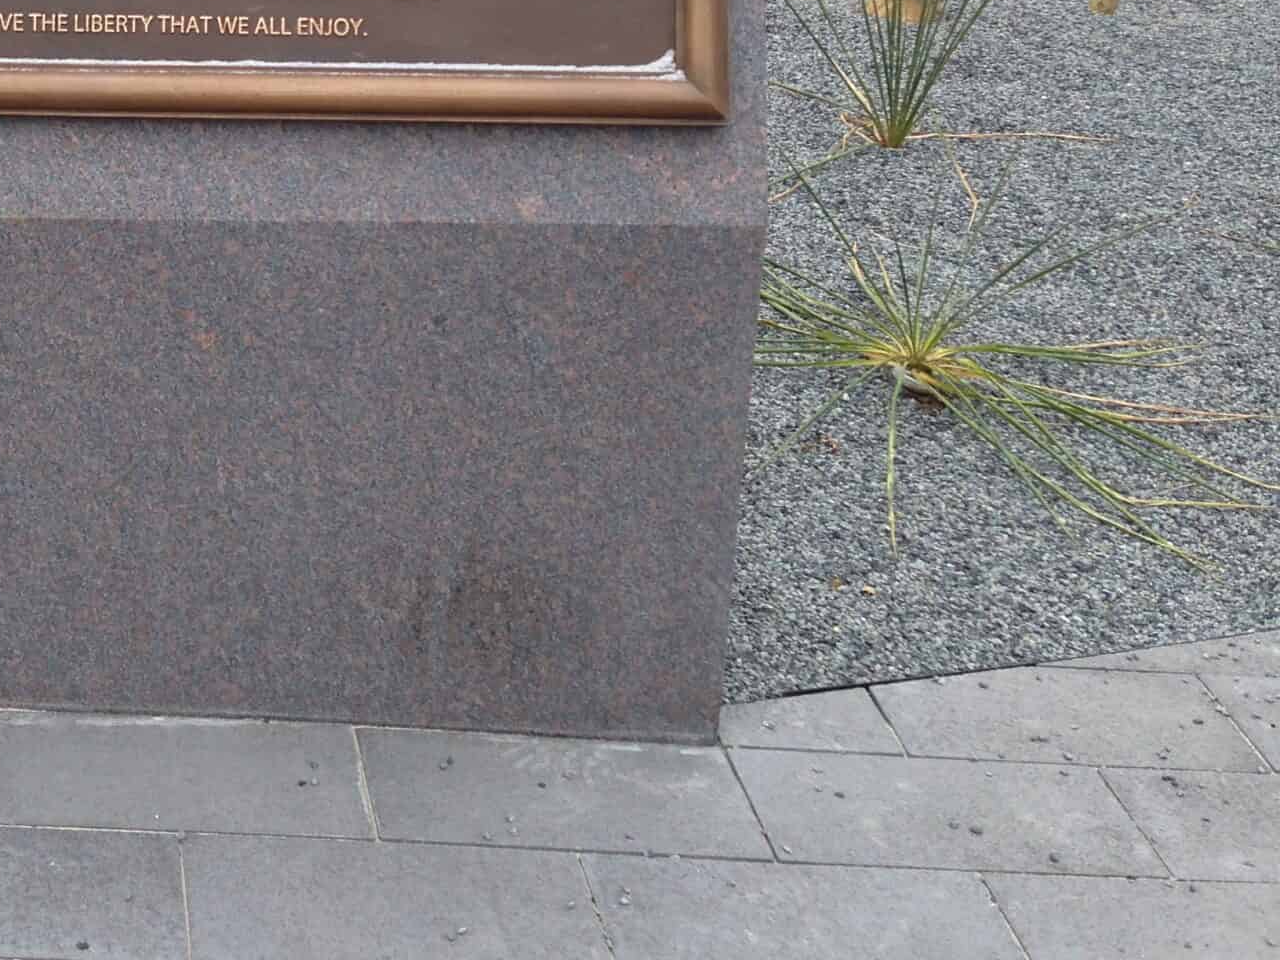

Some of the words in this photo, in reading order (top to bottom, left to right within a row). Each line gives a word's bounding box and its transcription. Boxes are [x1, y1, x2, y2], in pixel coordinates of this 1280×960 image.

[27, 12, 69, 33] THE
[73, 13, 155, 33] LIBERTY
[156, 13, 214, 34] THAT
[216, 15, 250, 35] WE
[253, 15, 293, 36] ALL
[295, 16, 369, 37] ENJOY.
